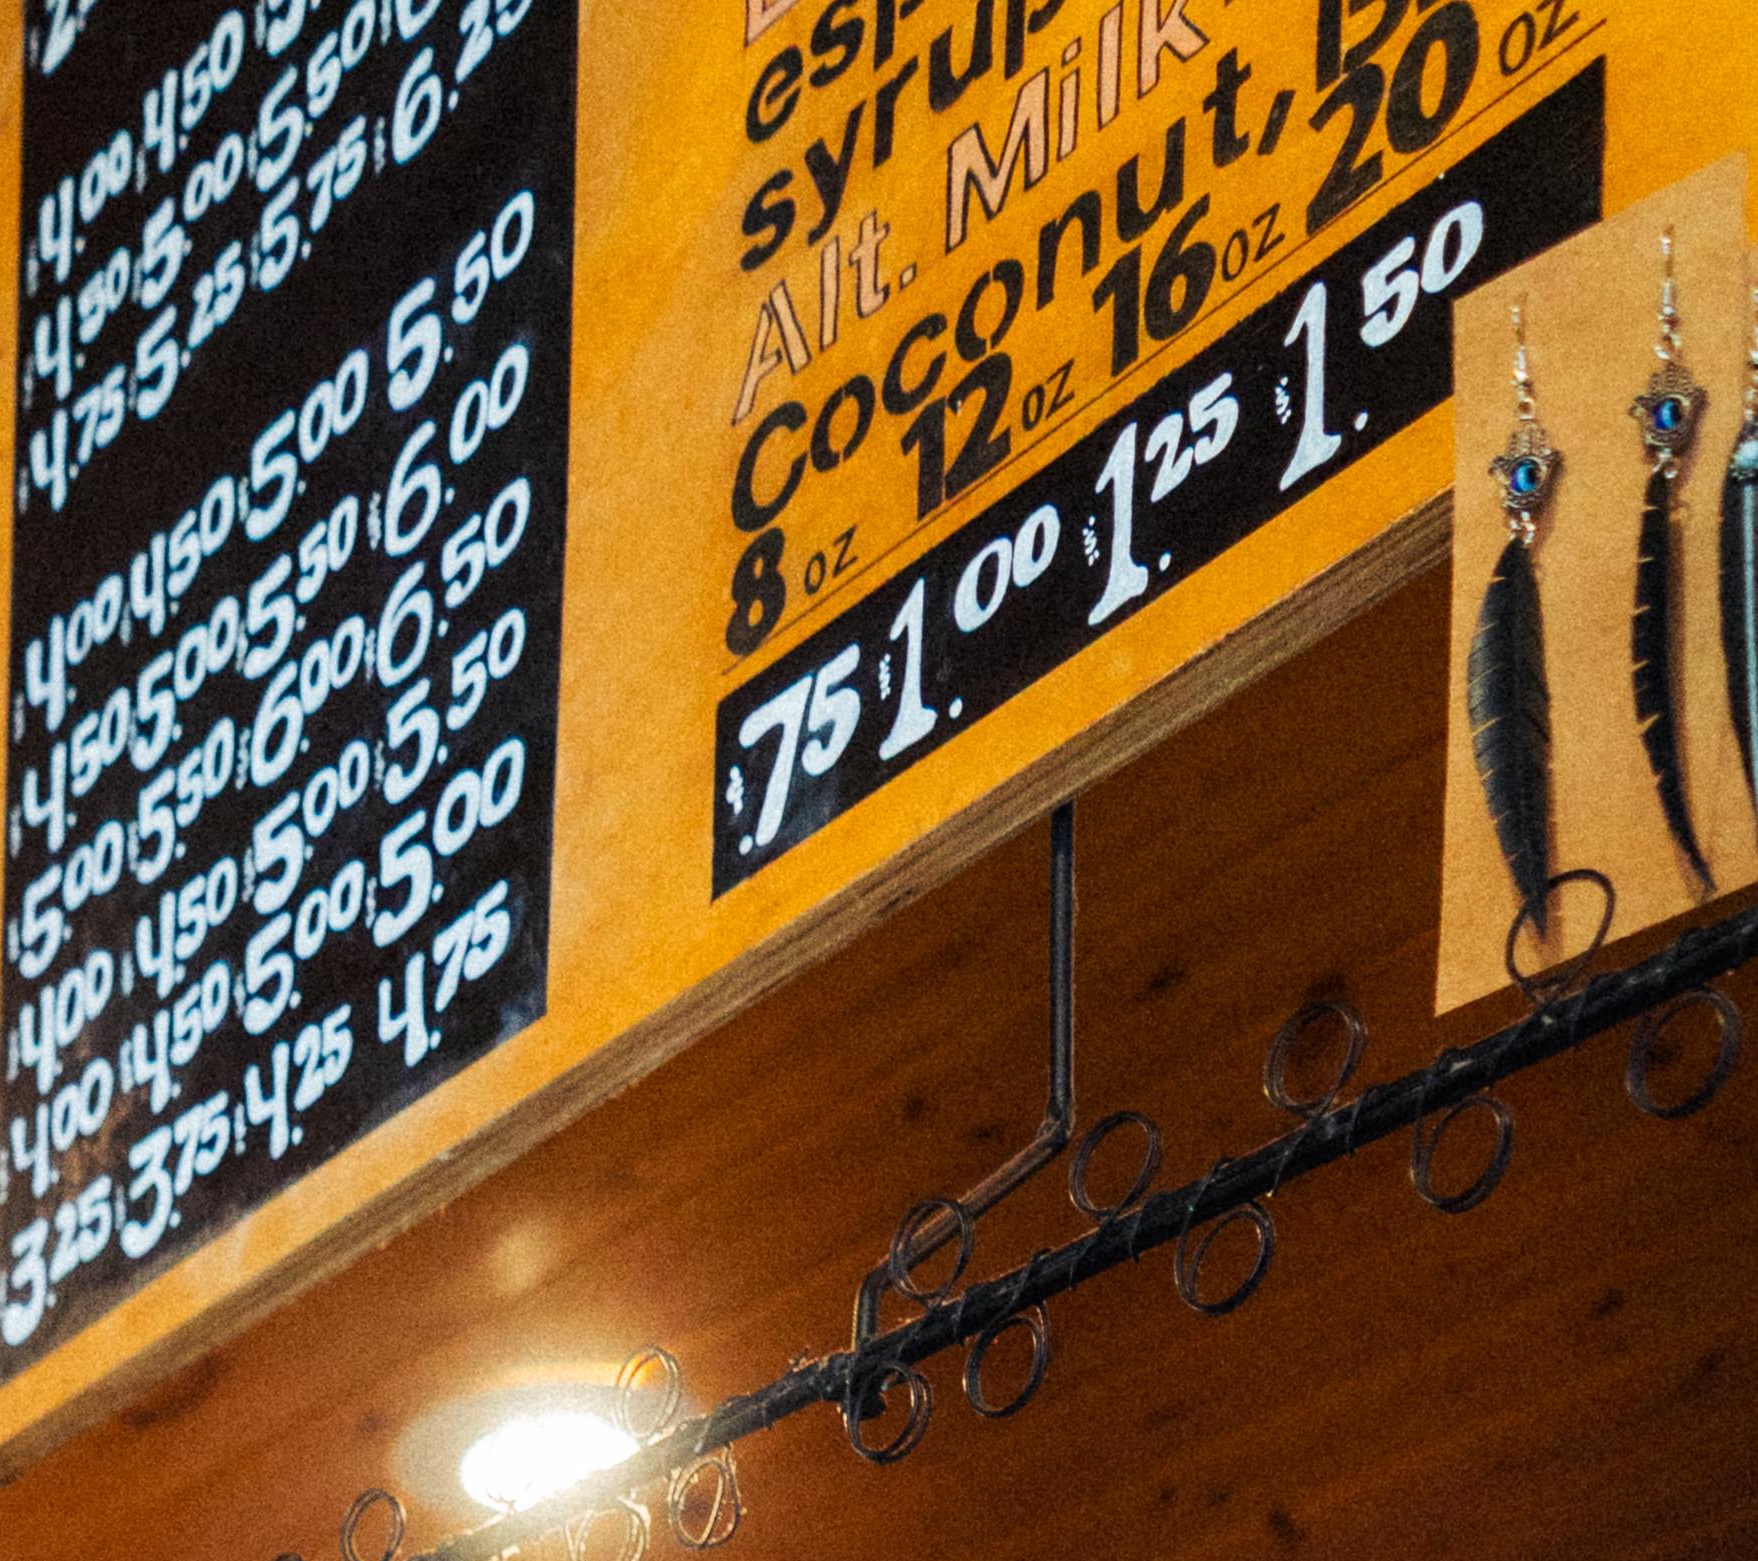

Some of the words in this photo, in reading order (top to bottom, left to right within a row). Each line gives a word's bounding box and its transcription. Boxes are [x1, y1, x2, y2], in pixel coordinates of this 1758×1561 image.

[730, 208, 919, 427] Alt.
[944, 0, 1211, 257] Milk
[730, 47, 1295, 533] Coconut,
[725, 529, 787, 656] 8
